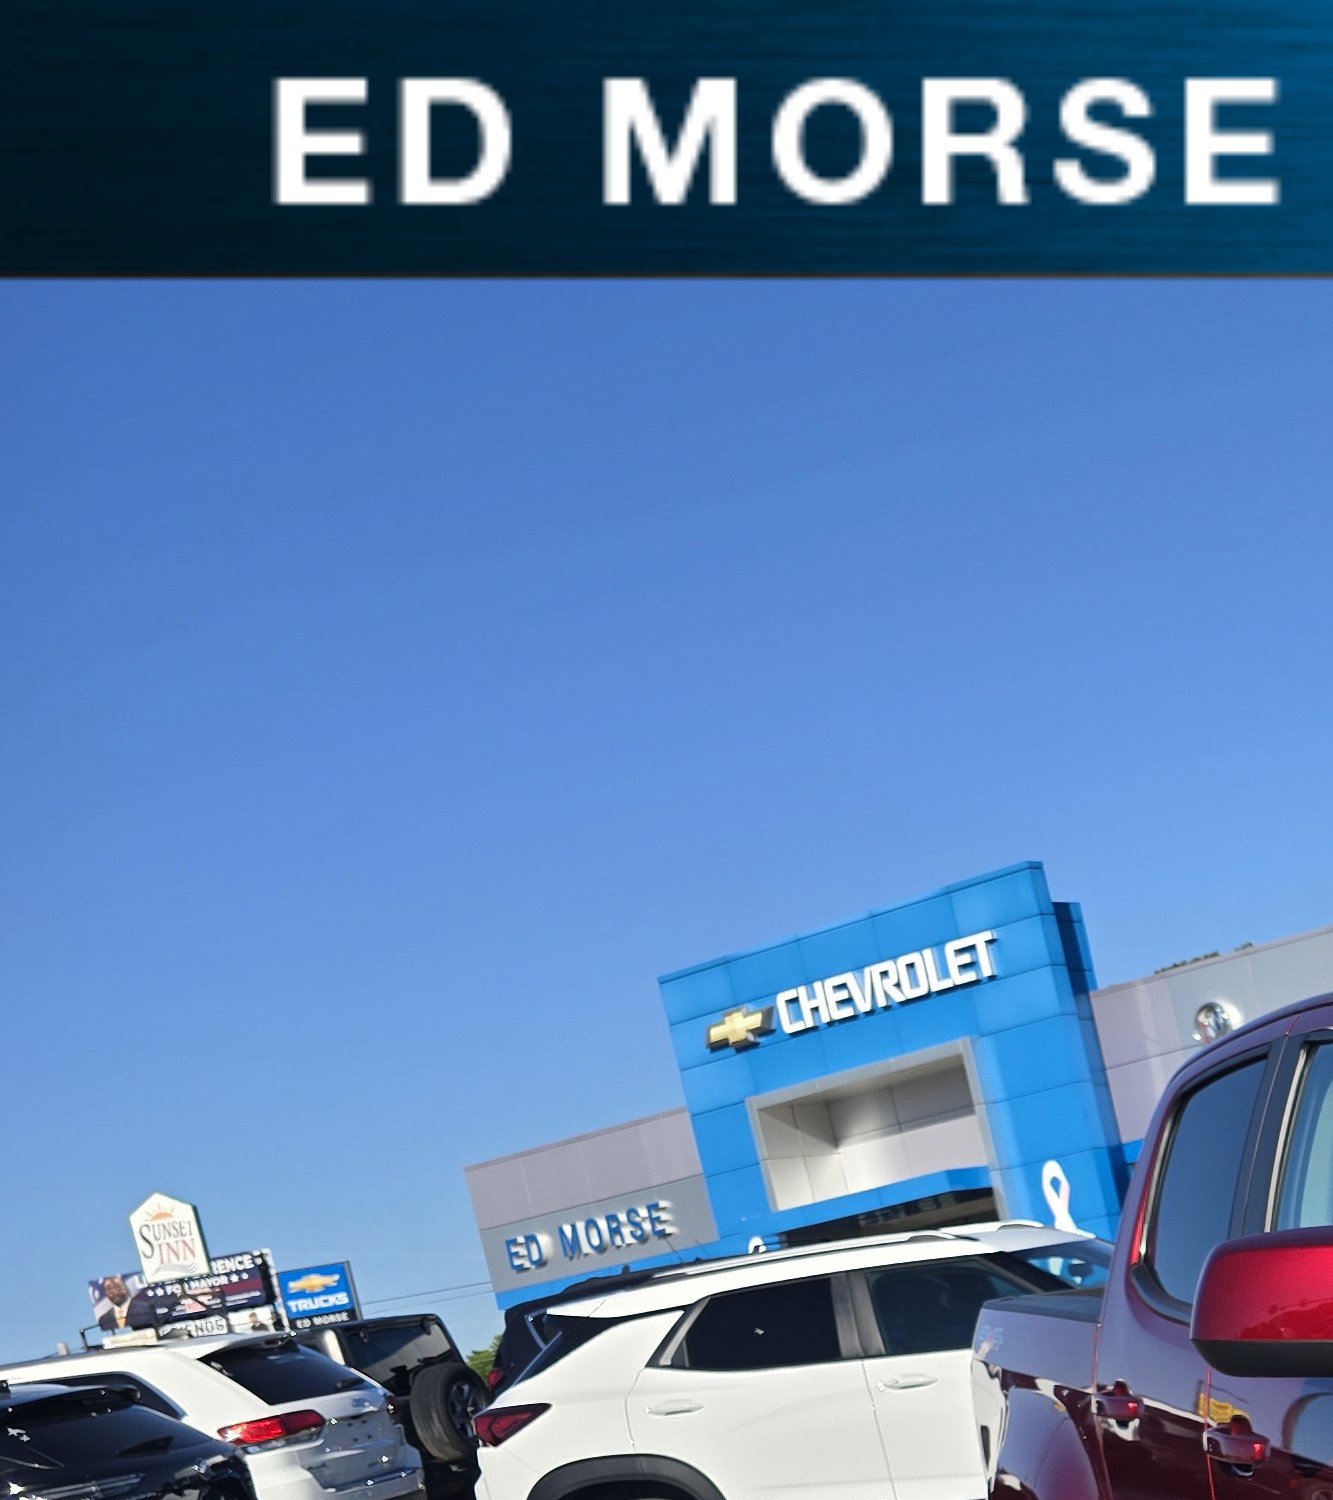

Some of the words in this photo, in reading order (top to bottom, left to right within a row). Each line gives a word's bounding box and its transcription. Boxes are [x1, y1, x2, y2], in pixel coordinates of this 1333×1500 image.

[776, 930, 993, 1034] CHEVROLET
[139, 1219, 193, 1260] SUNSET
[157, 1237, 197, 1265] INN
[505, 1233, 547, 1272] ED
[558, 1202, 671, 1260] MORSE
[287, 1291, 350, 1313] TRUCKS
